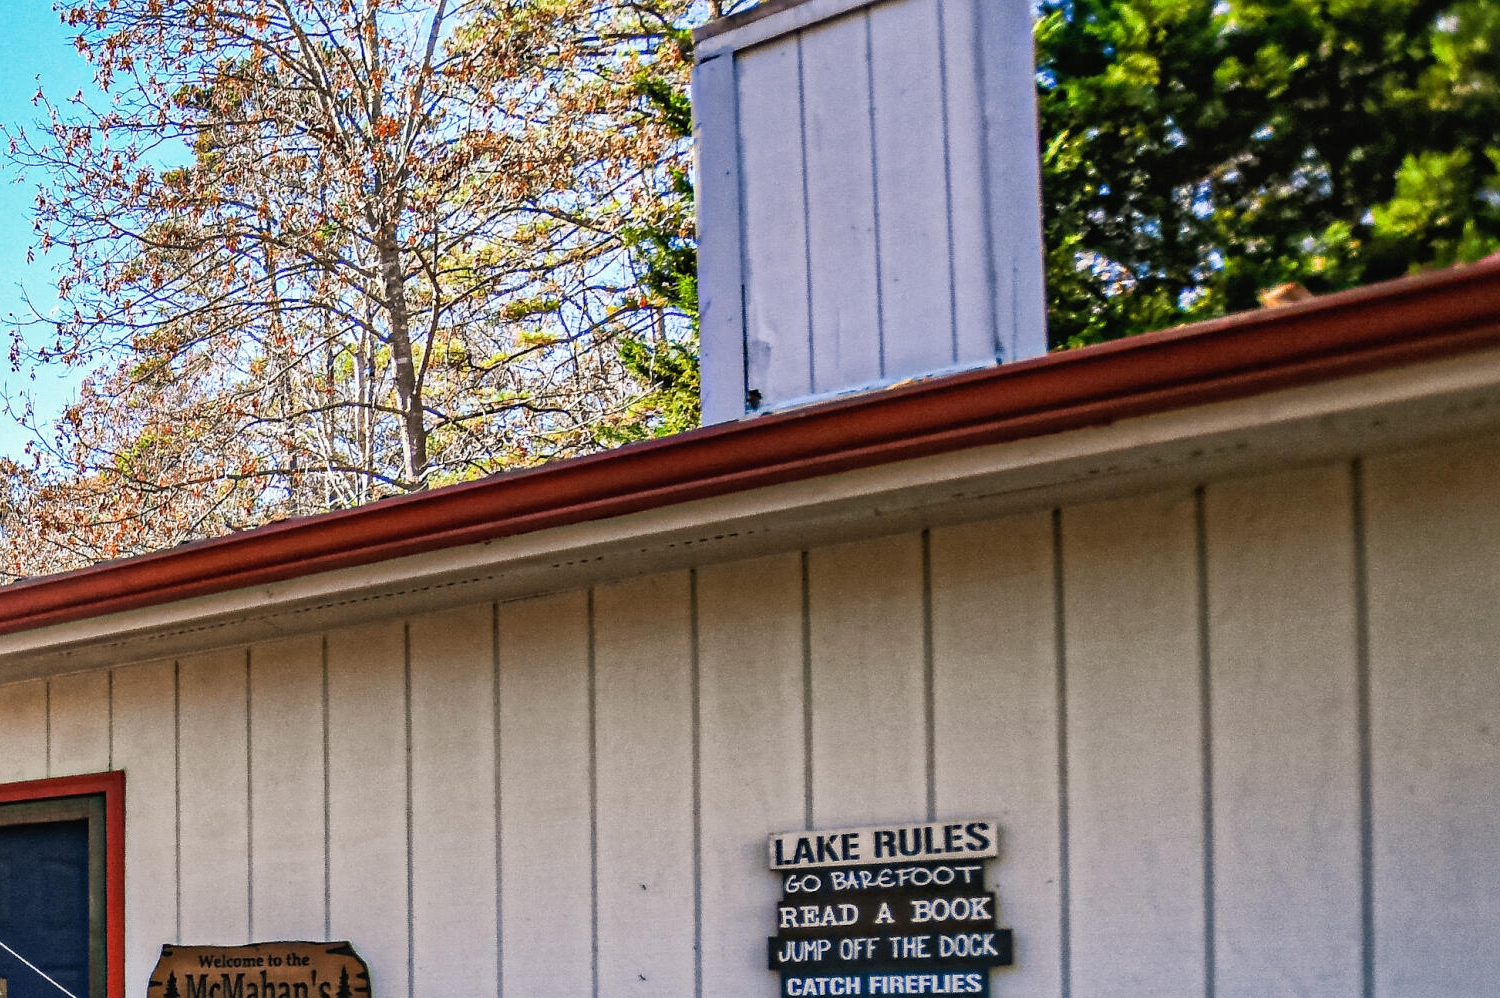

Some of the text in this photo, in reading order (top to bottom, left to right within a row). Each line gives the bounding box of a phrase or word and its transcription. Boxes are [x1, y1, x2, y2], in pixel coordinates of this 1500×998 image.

[774, 822, 990, 866] LAKE RULES
[785, 866, 982, 893] GO BAREFOOT
[779, 897, 992, 928] READ A BOOK
[199, 953, 310, 969] Welcome to the
[778, 933, 998, 963] JUMP OFF THE DOCK
[786, 973, 983, 996] CATCH FIREFLIES
